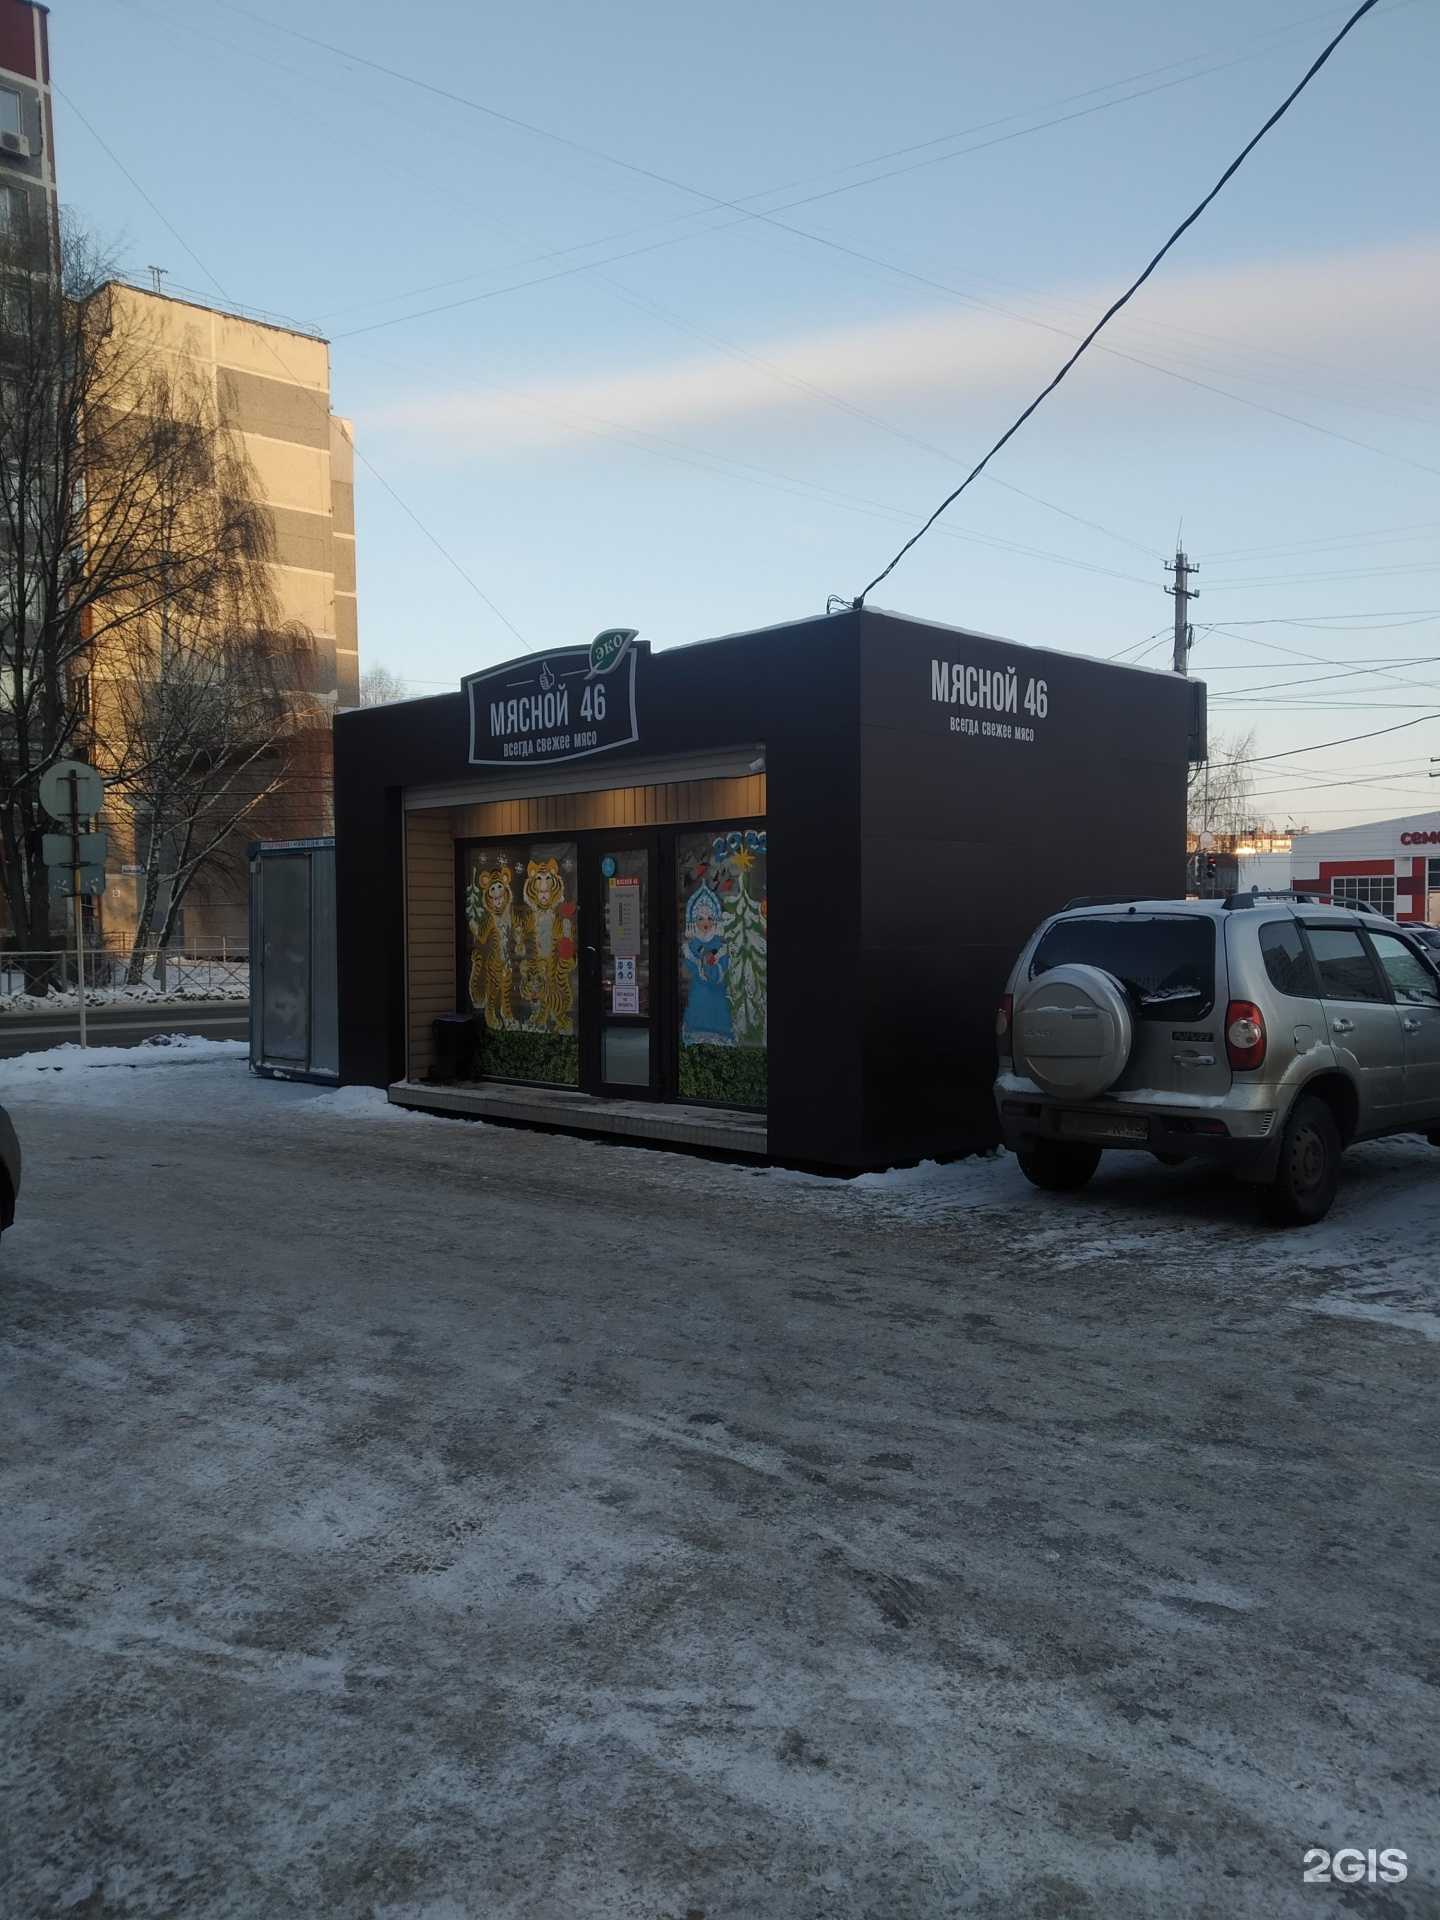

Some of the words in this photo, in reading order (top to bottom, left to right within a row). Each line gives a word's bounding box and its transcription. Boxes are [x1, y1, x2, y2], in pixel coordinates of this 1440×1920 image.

[490, 683, 569, 737] МЯСНОЙ
[580, 683, 606, 722] 46
[931, 659, 1018, 714] МЯСНОЙ
[1023, 678, 1048, 719] 46
